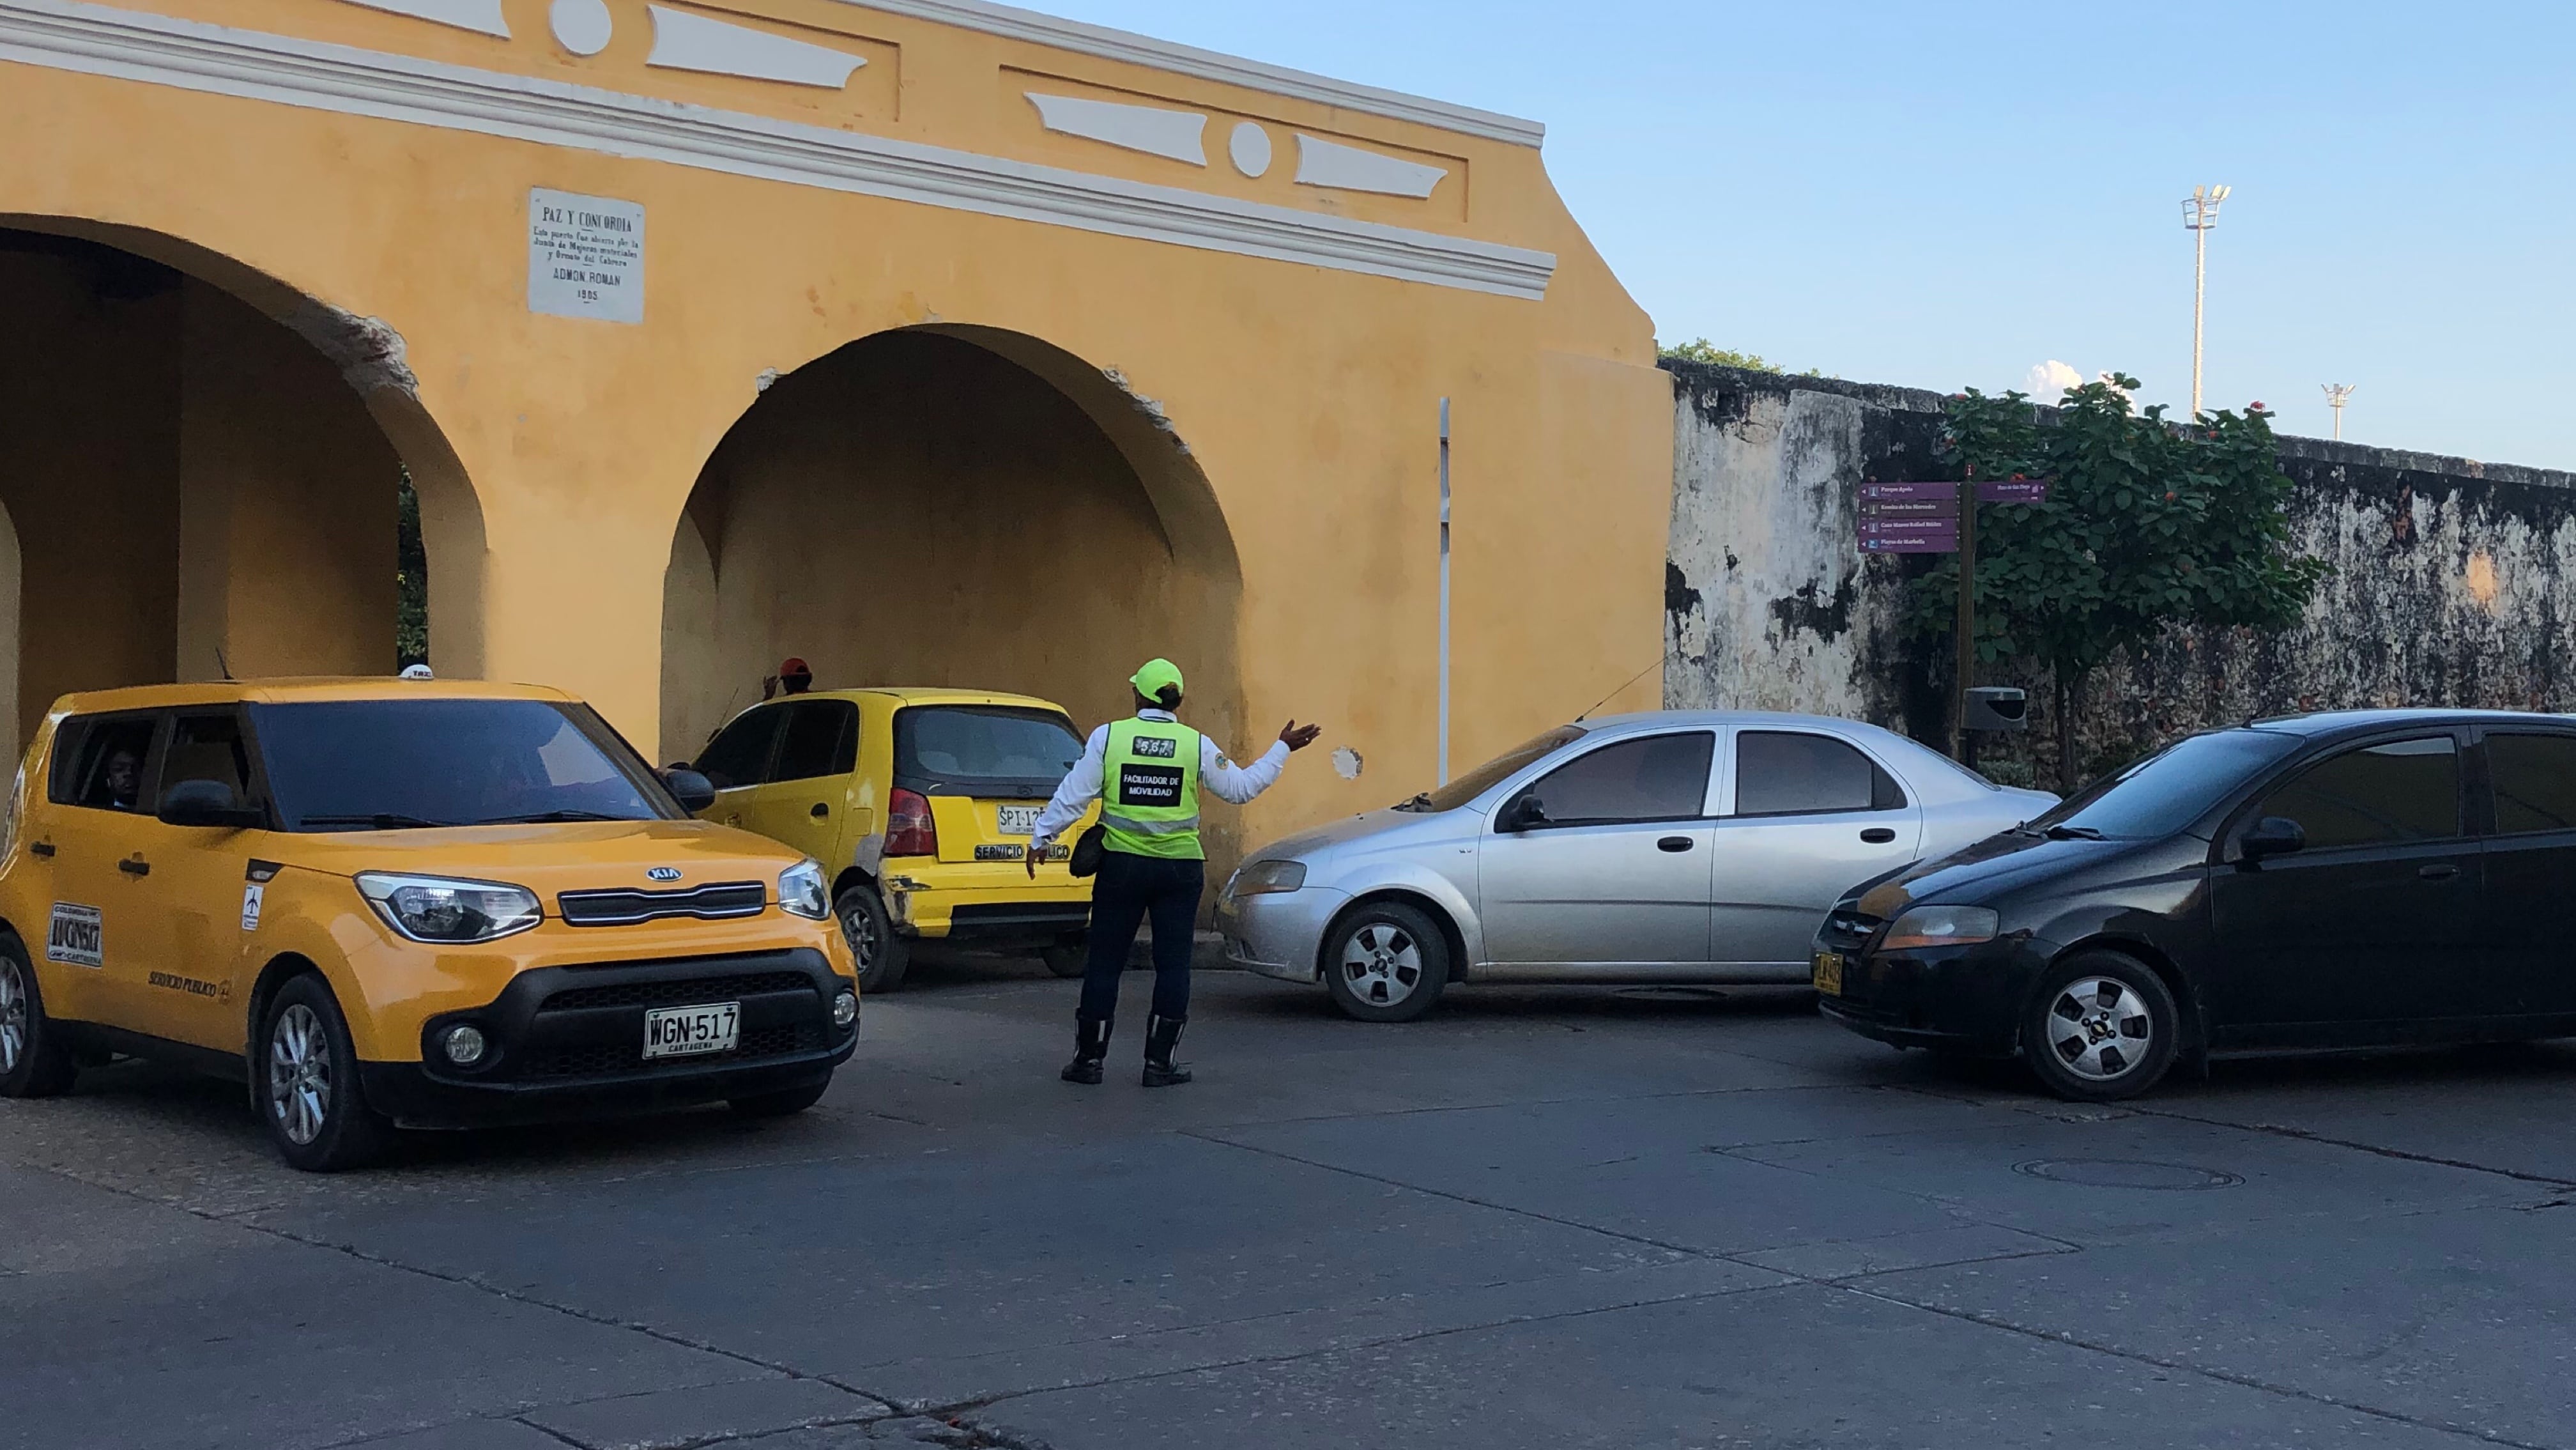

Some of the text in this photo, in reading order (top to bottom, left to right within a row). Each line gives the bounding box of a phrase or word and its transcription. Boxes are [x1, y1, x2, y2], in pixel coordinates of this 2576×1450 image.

[542, 206, 631, 232] PAZ Y CONCORDIA
[1124, 774, 1180, 785] FACILITADOR DE
[1129, 786, 1172, 796] MOVILIDAD
[976, 845, 1023, 860] SERVICIO
[651, 868, 679, 878] KIA
[668, 1042, 713, 1052] CARTAGENA
